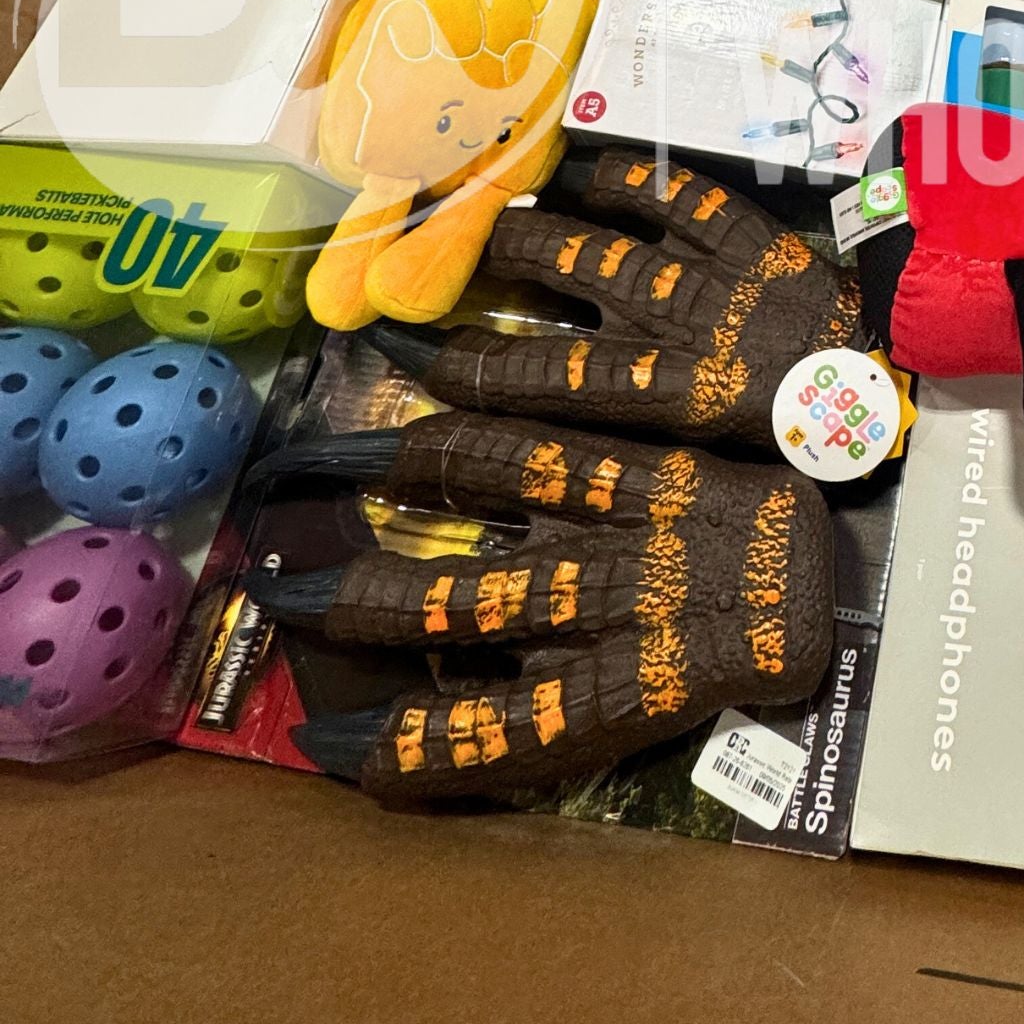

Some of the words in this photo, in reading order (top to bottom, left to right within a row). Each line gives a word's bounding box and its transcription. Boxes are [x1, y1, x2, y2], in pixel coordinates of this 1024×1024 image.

[585, 98, 601, 117] A5
[35, 188, 131, 210] PICKLEBALLS
[78, 206, 124, 226] HOLE
[101, 197, 230, 293] 40
[798, 384, 867, 461] scape
[803, 444, 819, 463] Plush
[960, 408, 992, 505] wired
[930, 516, 985, 773] headphones
[805, 648, 857, 835] Spinosaurus
[788, 768, 808, 830] BATTLE
